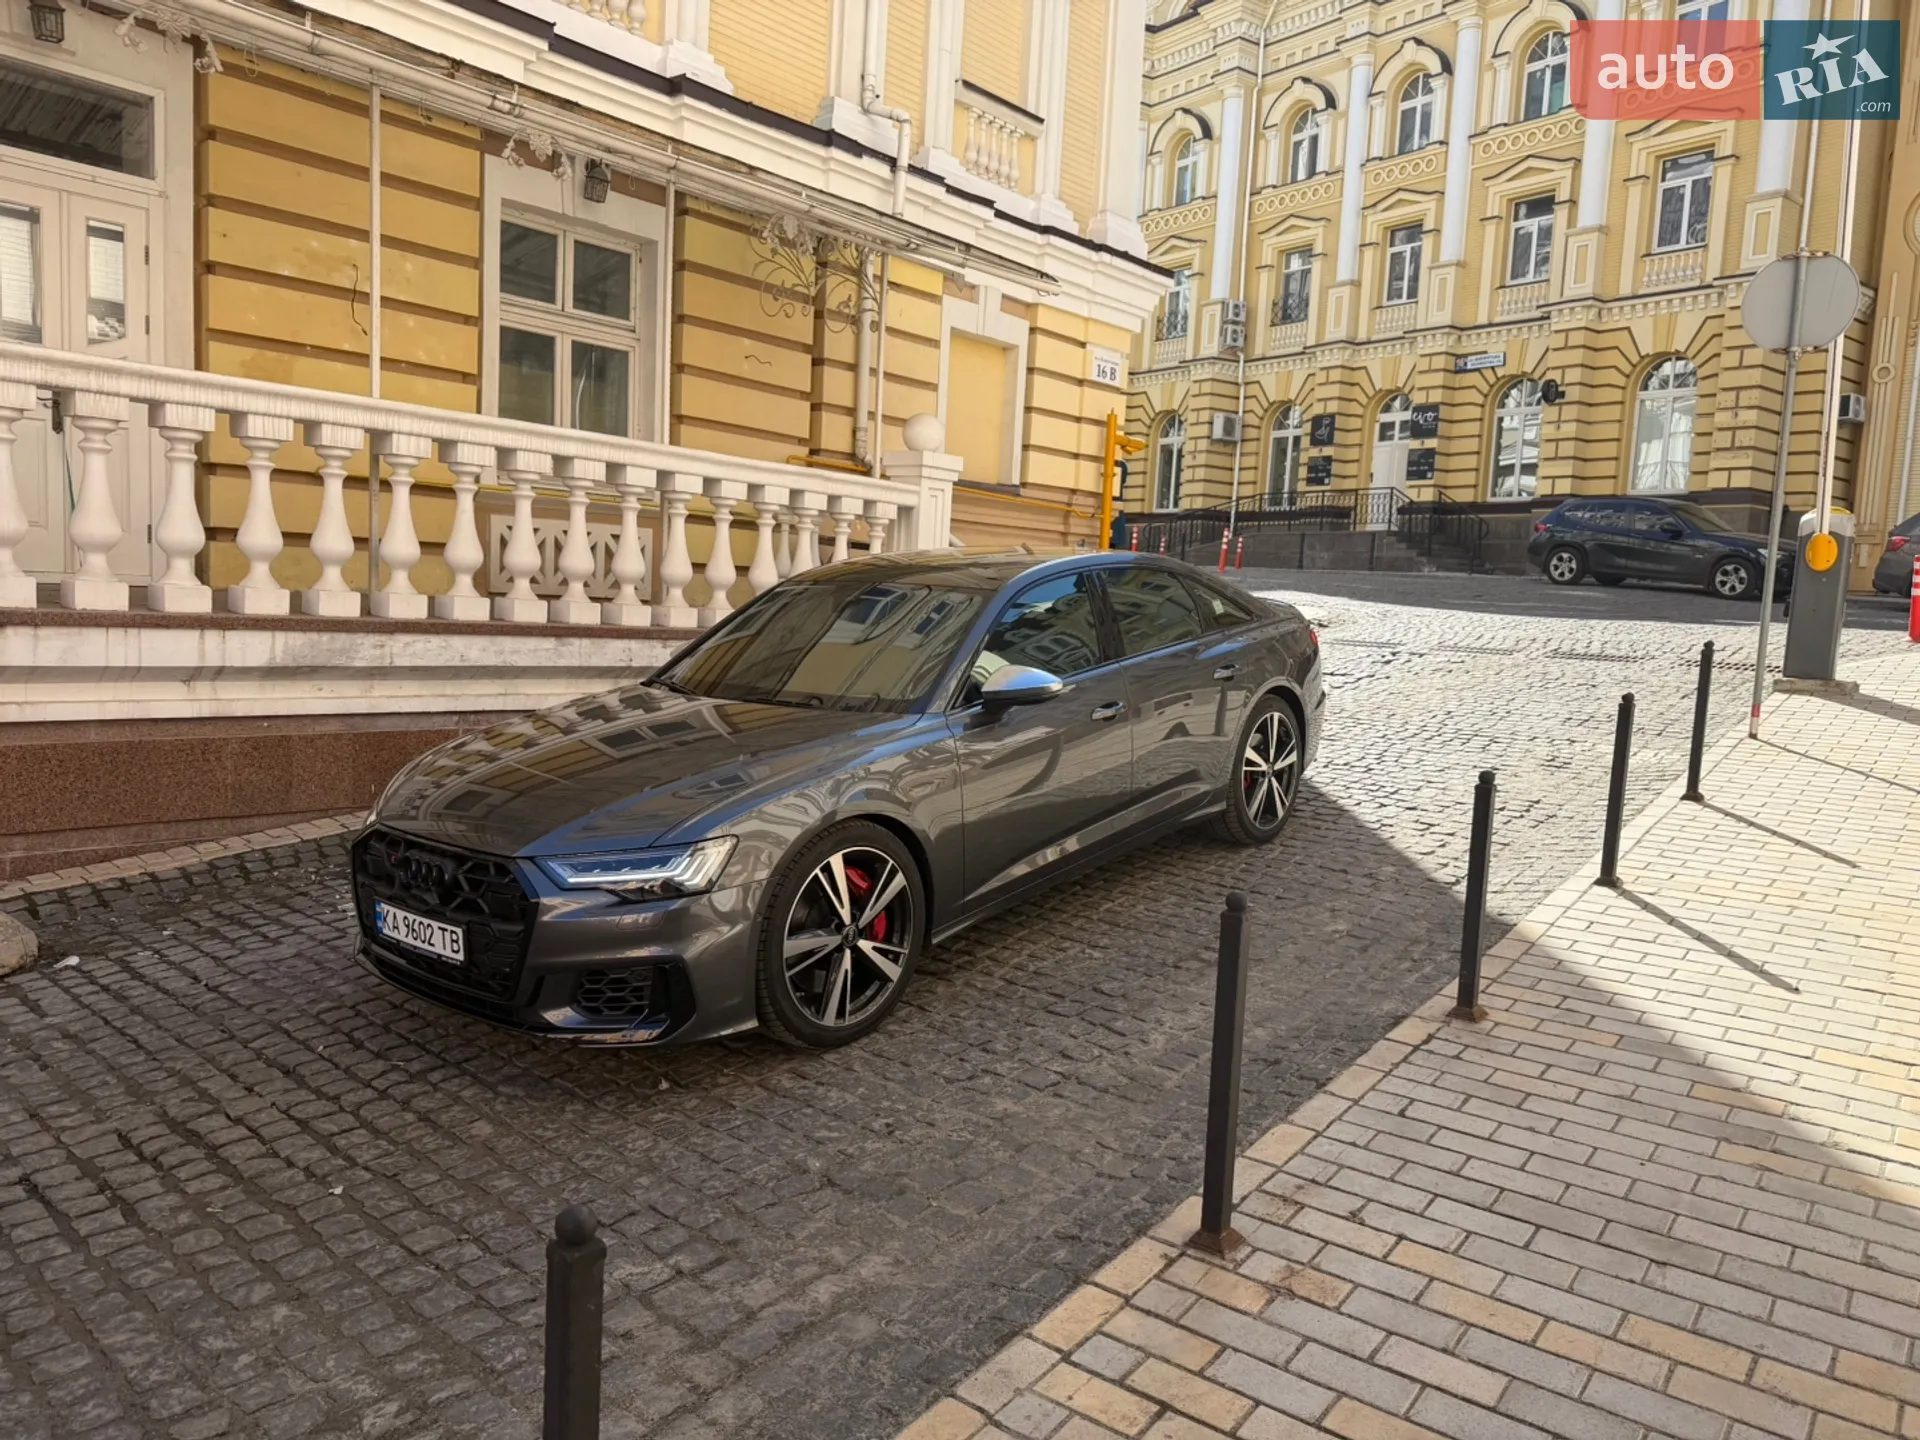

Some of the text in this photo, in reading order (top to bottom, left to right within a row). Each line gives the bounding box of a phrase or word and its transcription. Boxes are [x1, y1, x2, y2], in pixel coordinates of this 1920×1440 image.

[383, 909, 401, 936] KA
[402, 915, 436, 948] 9602
[437, 926, 461, 954] TB
